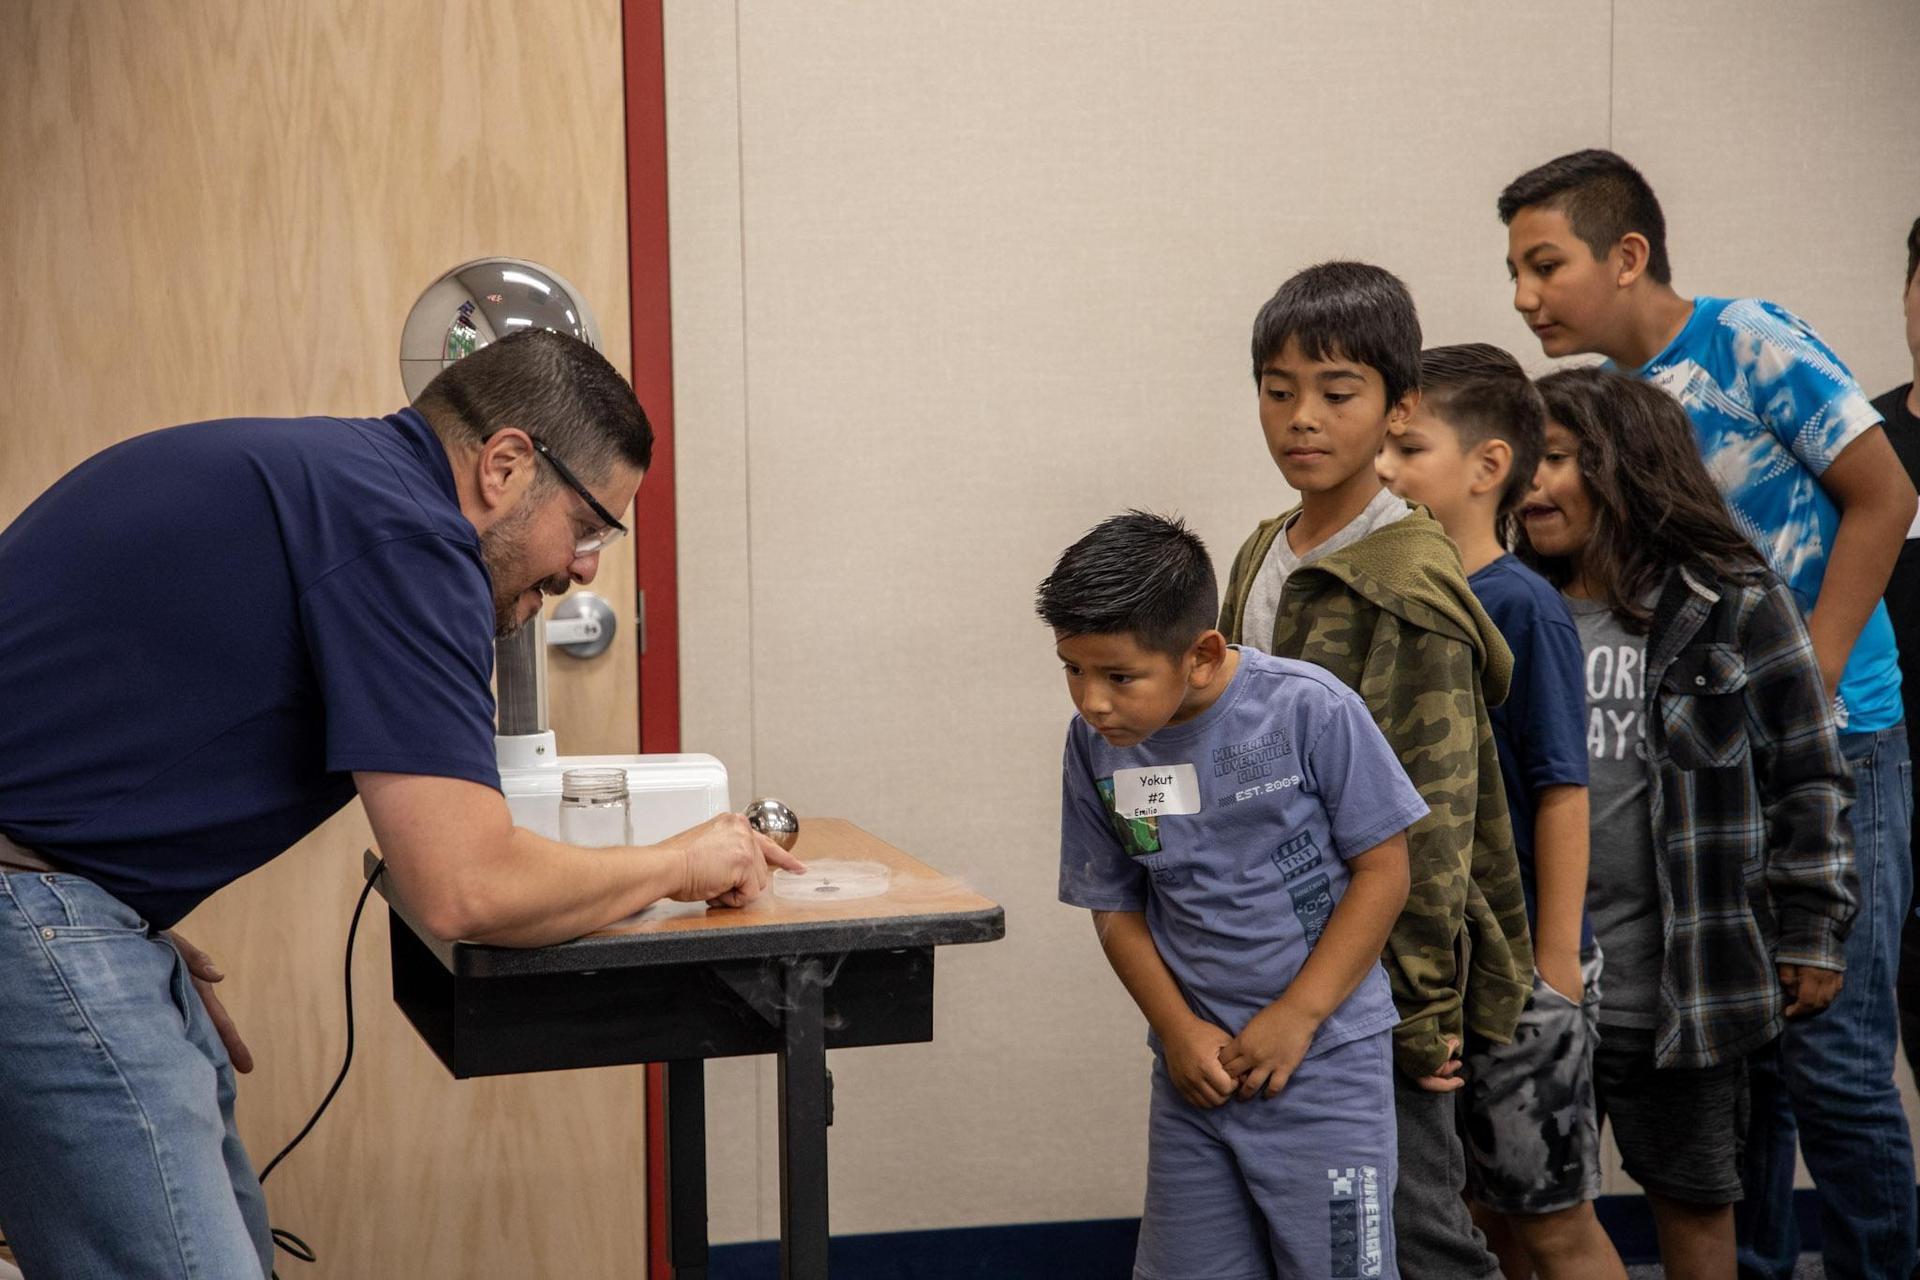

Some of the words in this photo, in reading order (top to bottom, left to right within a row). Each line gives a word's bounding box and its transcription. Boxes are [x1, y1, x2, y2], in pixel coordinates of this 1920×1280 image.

[1586, 645, 1646, 700] OR
[1140, 774, 1173, 787] Yokut
[1235, 786, 1263, 801] EST.
[1264, 775, 1300, 792] 2009
[1148, 792, 1165, 804] #2
[1134, 807, 1158, 817] Emilio
[1282, 848, 1312, 869] TNT
